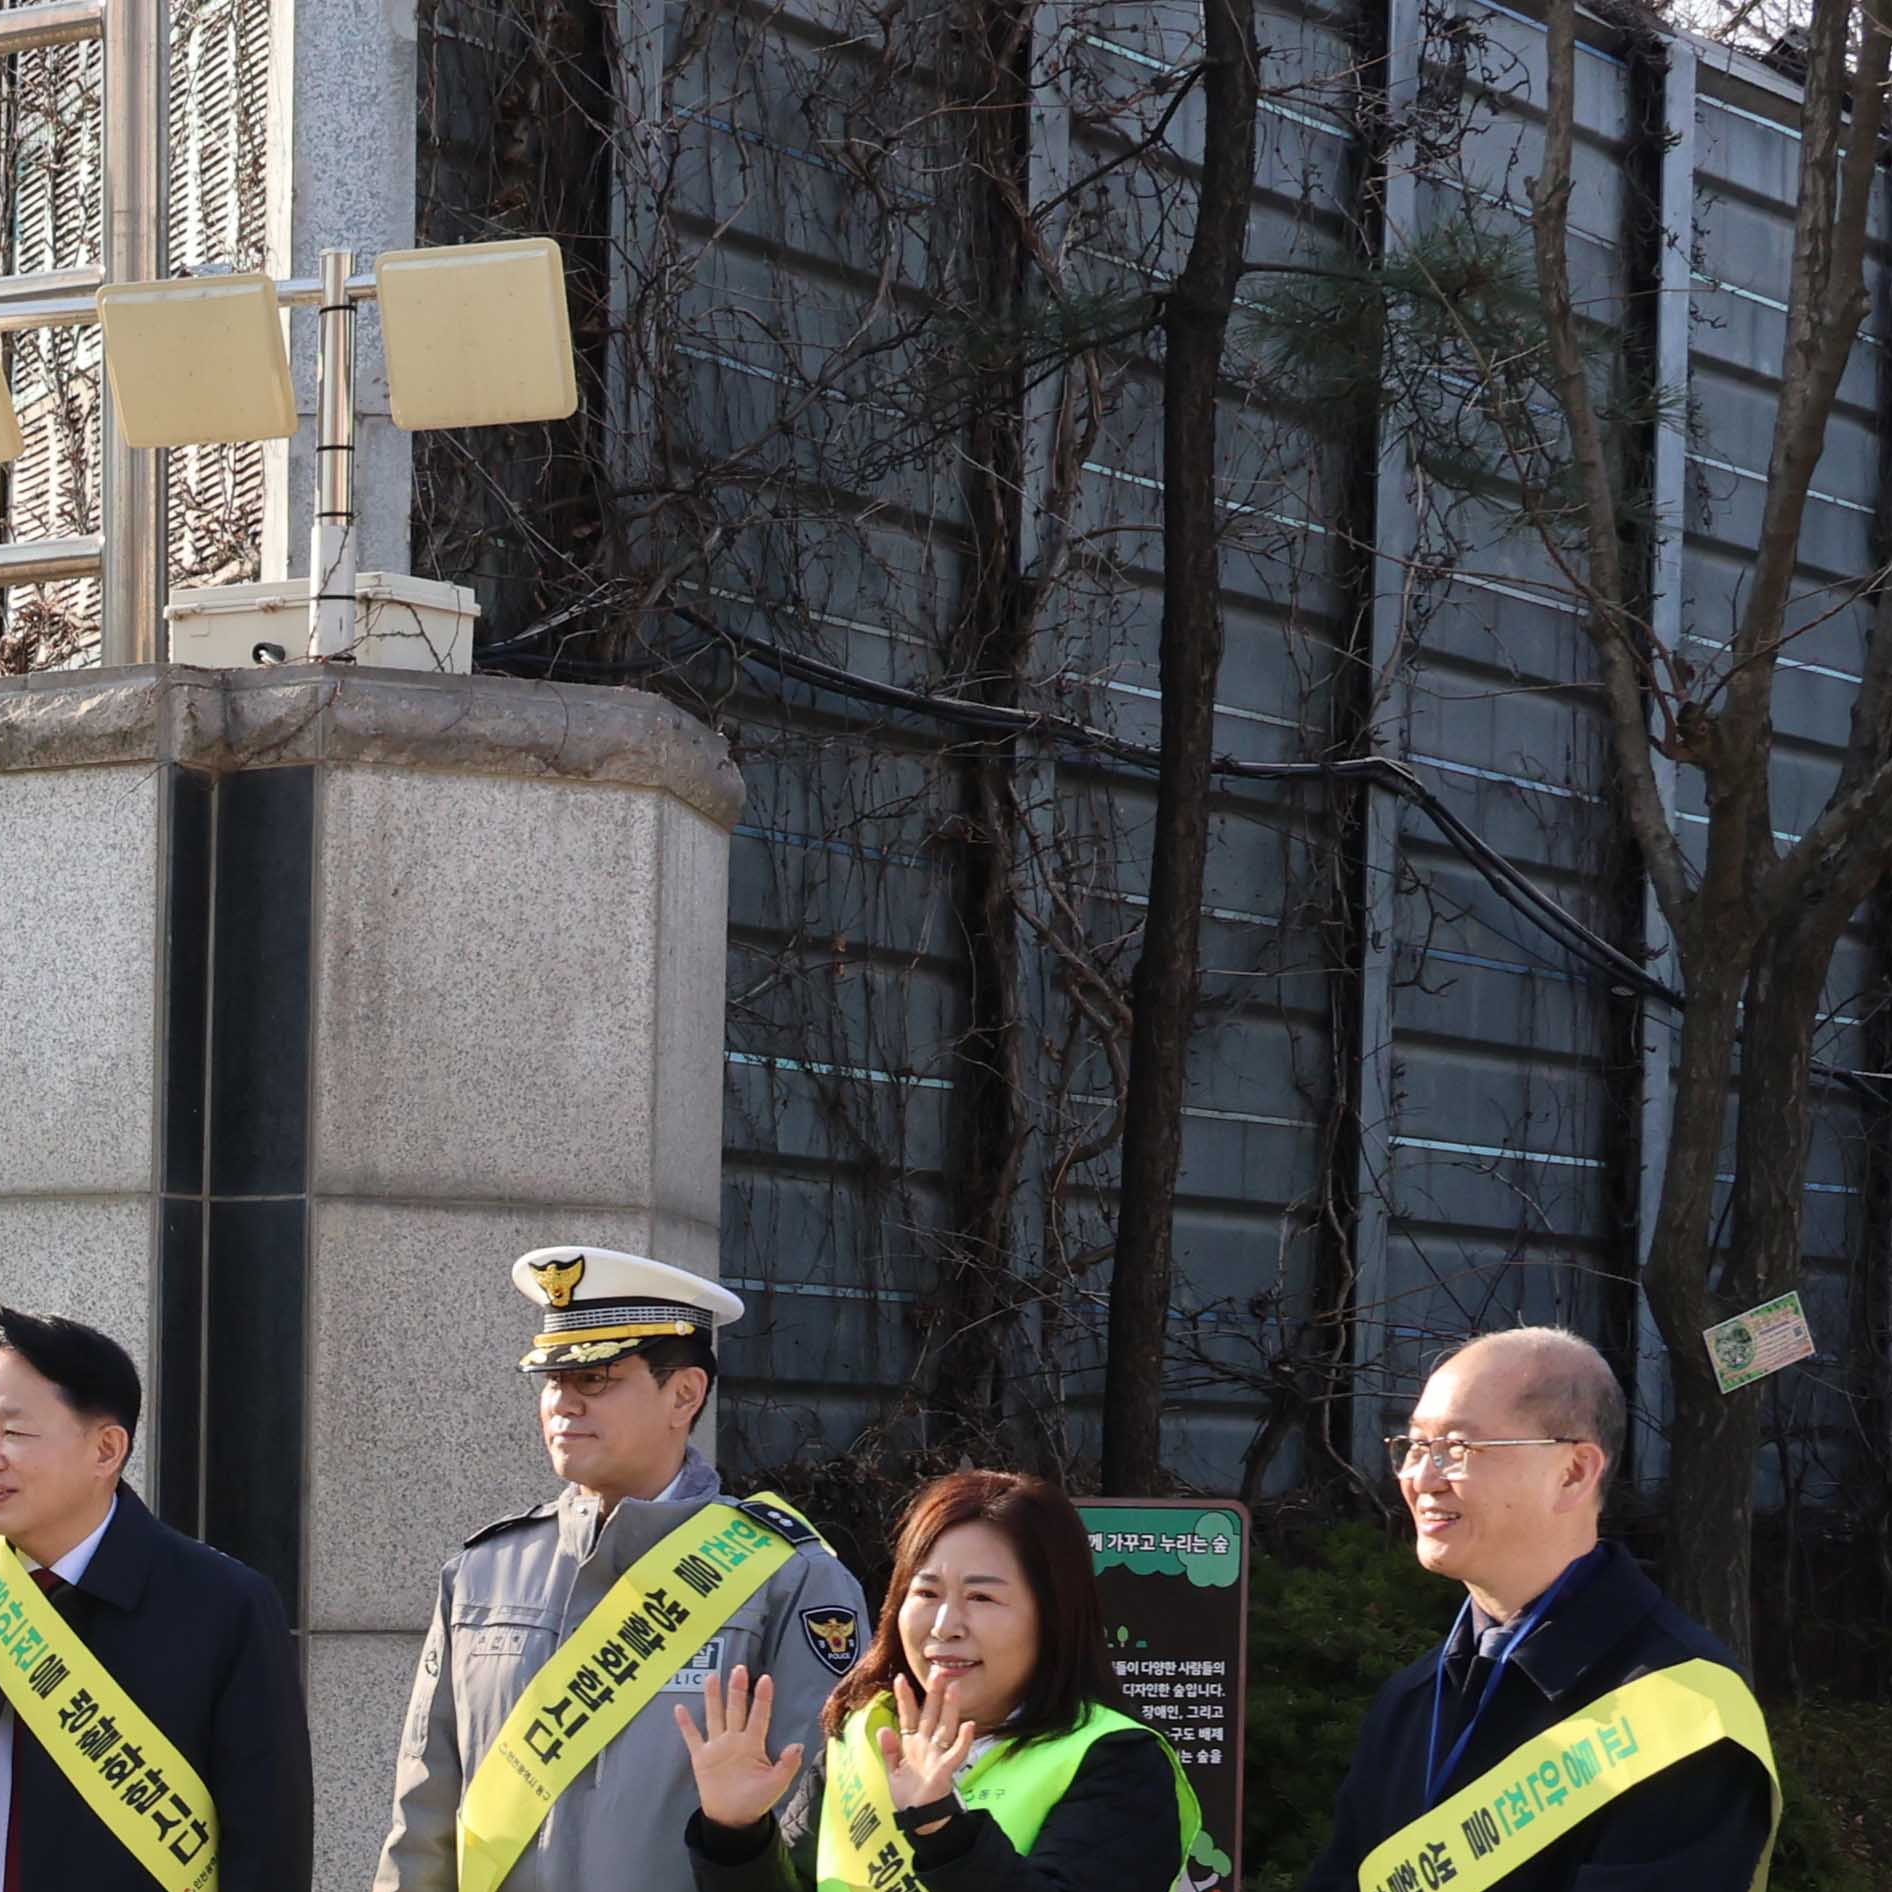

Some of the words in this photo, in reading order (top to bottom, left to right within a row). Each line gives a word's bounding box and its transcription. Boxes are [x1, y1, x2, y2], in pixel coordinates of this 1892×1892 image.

[1107, 1533, 1157, 1554] 가꾸고
[1159, 1533, 1209, 1554] 누리는
[1212, 1533, 1230, 1554] 숲
[828, 1651, 852, 1661] POLICE
[1112, 1660, 1139, 1676] 들이
[1141, 1660, 1177, 1676] 다양한
[1178, 1660, 1226, 1676] 사람들의
[522, 1587, 692, 1766] 생활화합시다
[1122, 1682, 1171, 1698] 디자인한
[1173, 1682, 1227, 1698] 숲입니다.
[1141, 1704, 1184, 1720] 장애인,
[1186, 1704, 1225, 1720] 그리고
[1165, 1726, 1196, 1742] 구도
[1197, 1726, 1224, 1742] 배제
[1196, 1748, 1223, 1765] 숲을
[57, 1687, 211, 1866] 생활화합시다
[1460, 1715, 1640, 1861] 교통안전을
